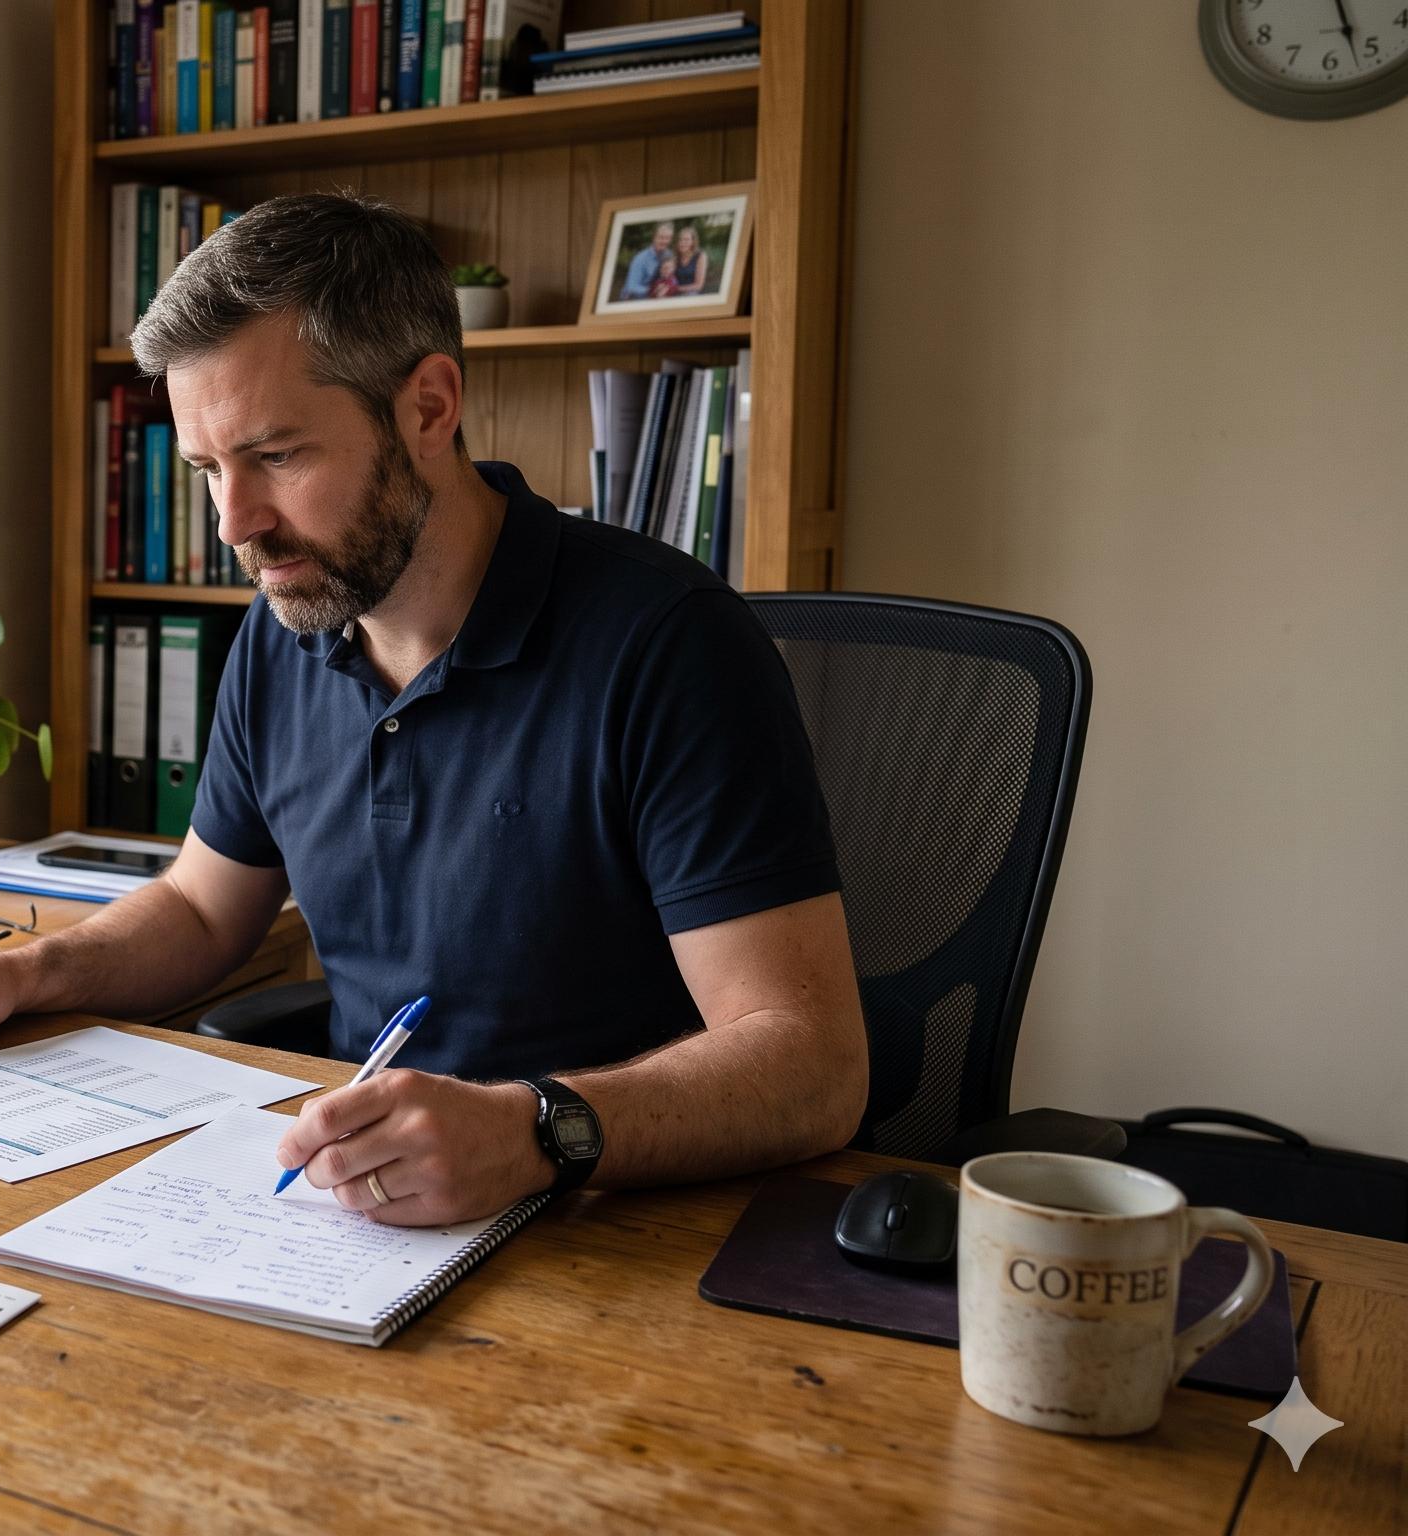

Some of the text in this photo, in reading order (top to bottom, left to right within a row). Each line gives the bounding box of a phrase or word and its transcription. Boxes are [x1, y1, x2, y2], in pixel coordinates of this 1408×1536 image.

[1392, 7, 1407, 29] 4
[1256, 23, 1272, 45] 8
[1285, 43, 1302, 66] 7
[1363, 36, 1378, 58] 5
[1322, 50, 1339, 71] 6
[1008, 1258, 1169, 1303] COFFEE
